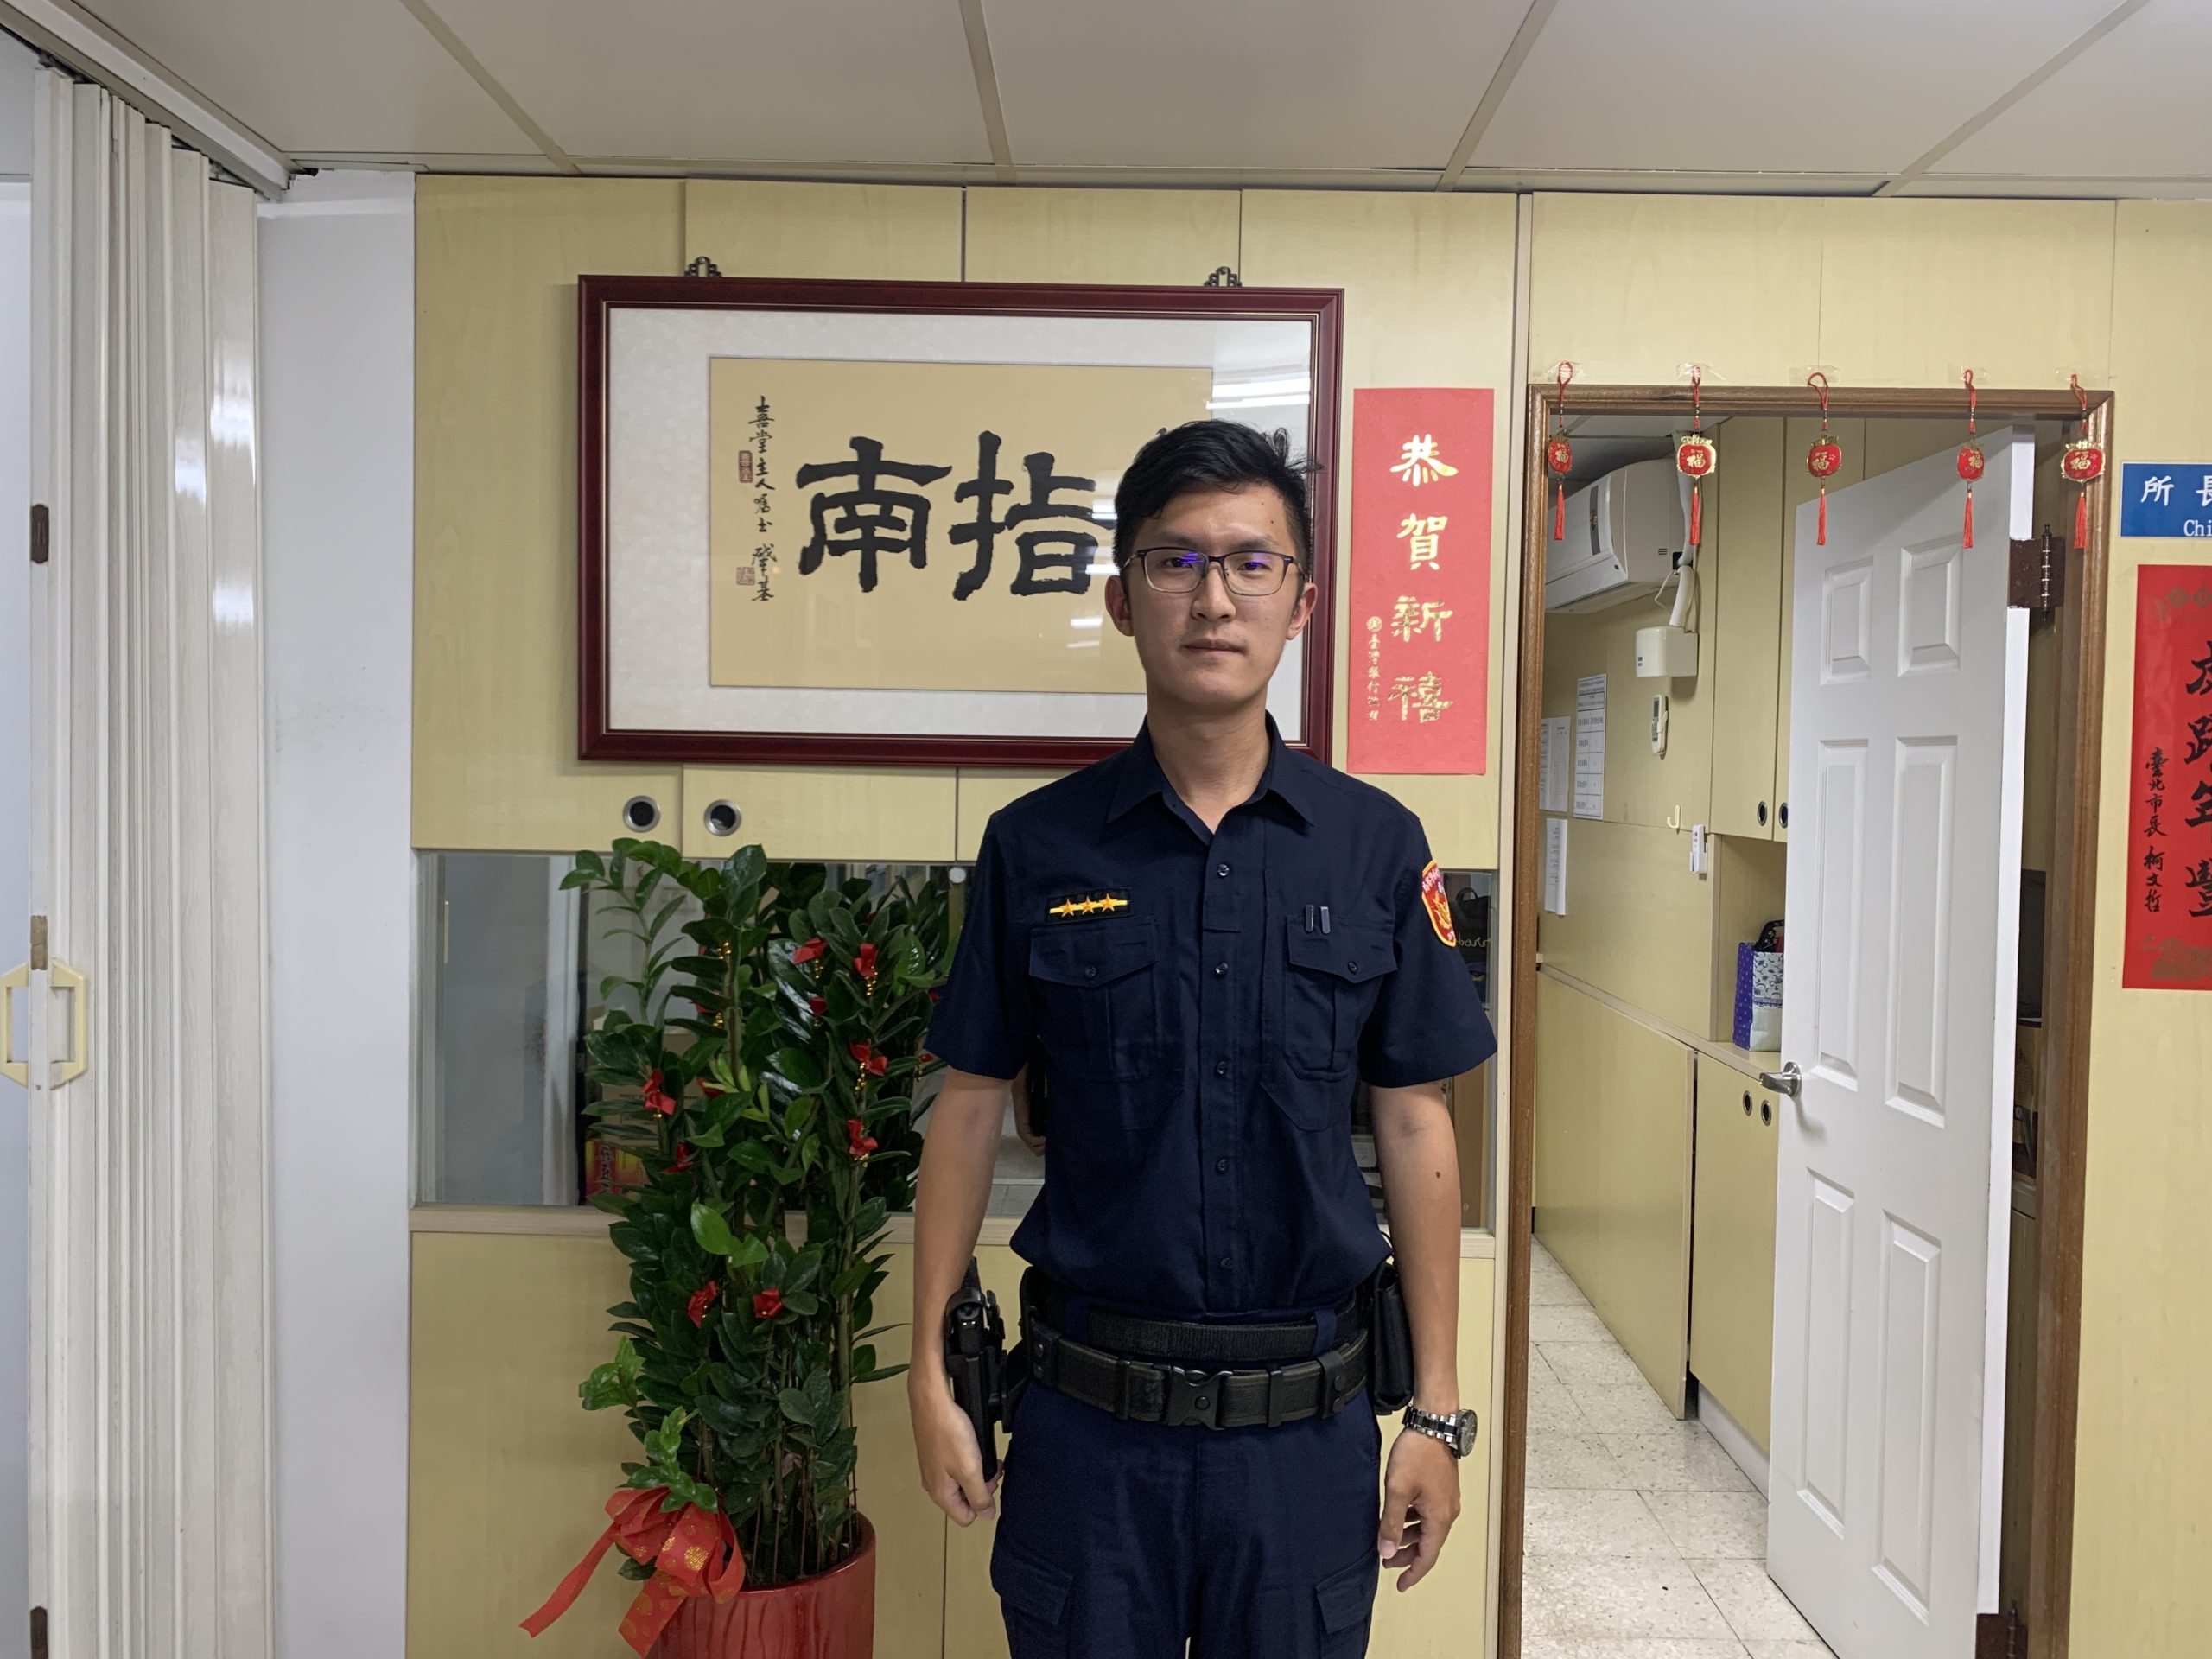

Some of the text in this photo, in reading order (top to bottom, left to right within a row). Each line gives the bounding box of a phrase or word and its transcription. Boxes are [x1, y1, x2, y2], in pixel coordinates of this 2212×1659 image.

[1687, 448, 1706, 468] 福
[1811, 451, 1830, 471] 福
[2069, 450, 2092, 470] 福
[1387, 434, 1459, 724] 恭賀新禧
